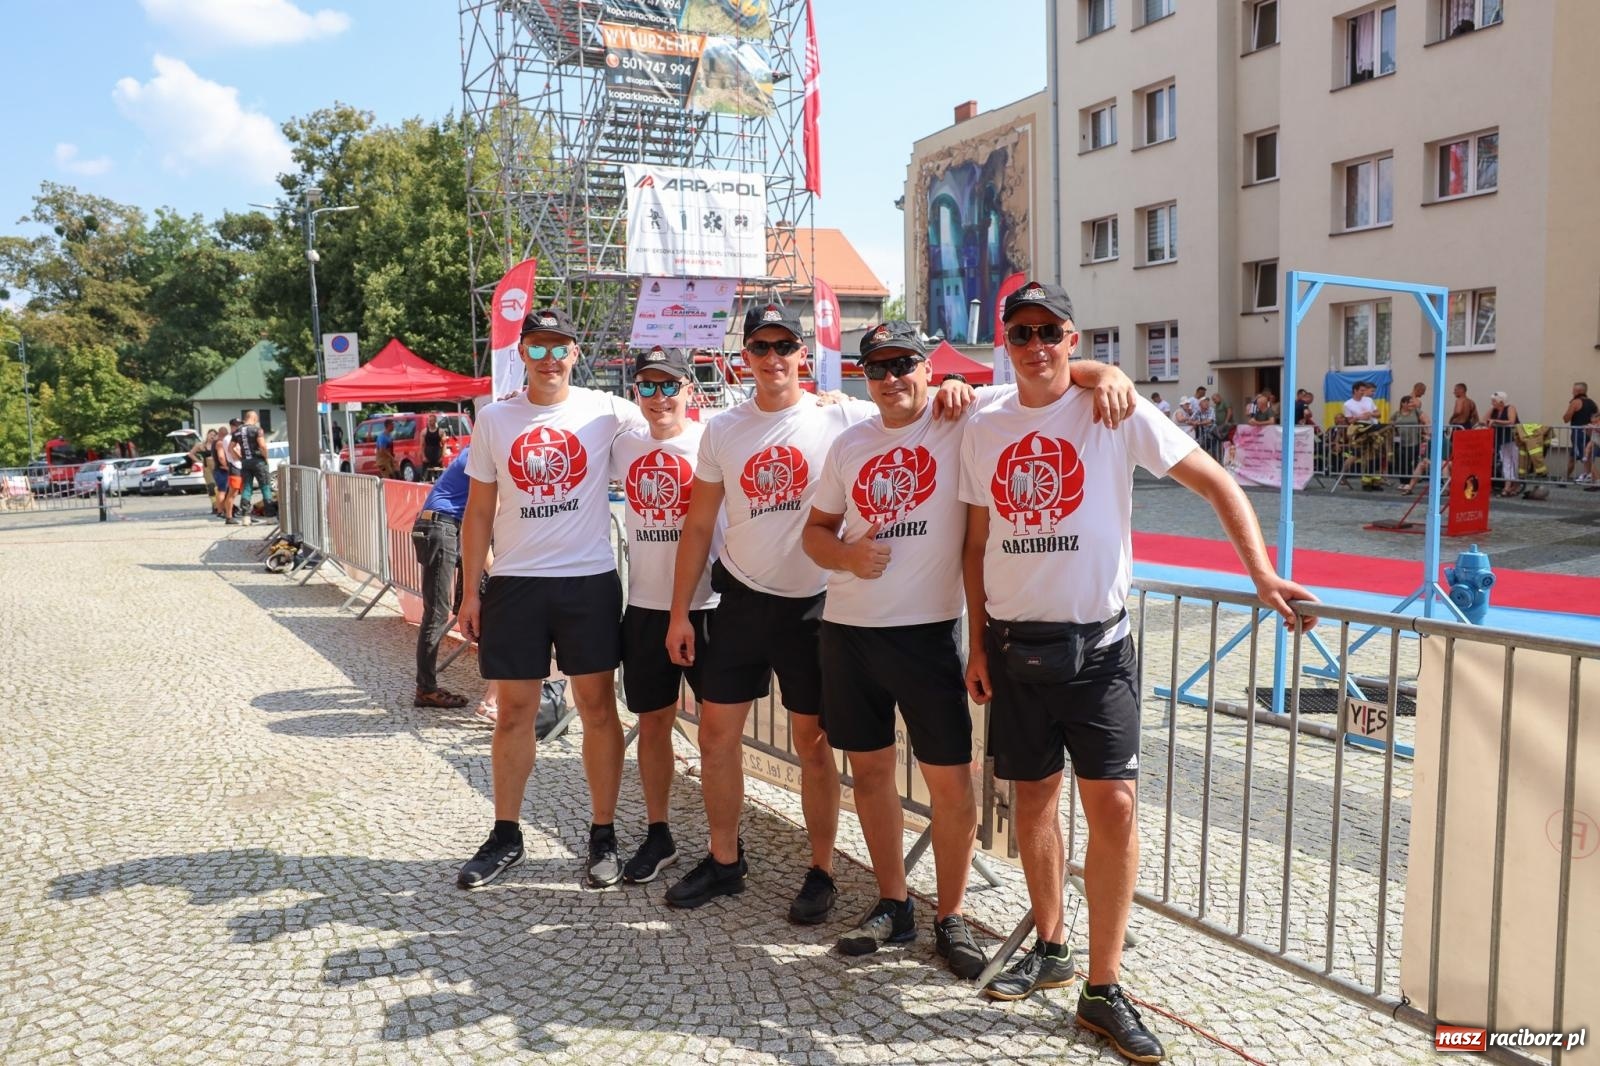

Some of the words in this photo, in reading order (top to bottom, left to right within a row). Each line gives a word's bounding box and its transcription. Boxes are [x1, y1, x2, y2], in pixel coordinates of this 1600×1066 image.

[622, 57, 642, 70] 501
[646, 60, 667, 74] 747
[670, 63, 691, 76] 994
[662, 178, 761, 197] ARPAPOL
[1002, 535, 1079, 554] RACIBÓRZ
